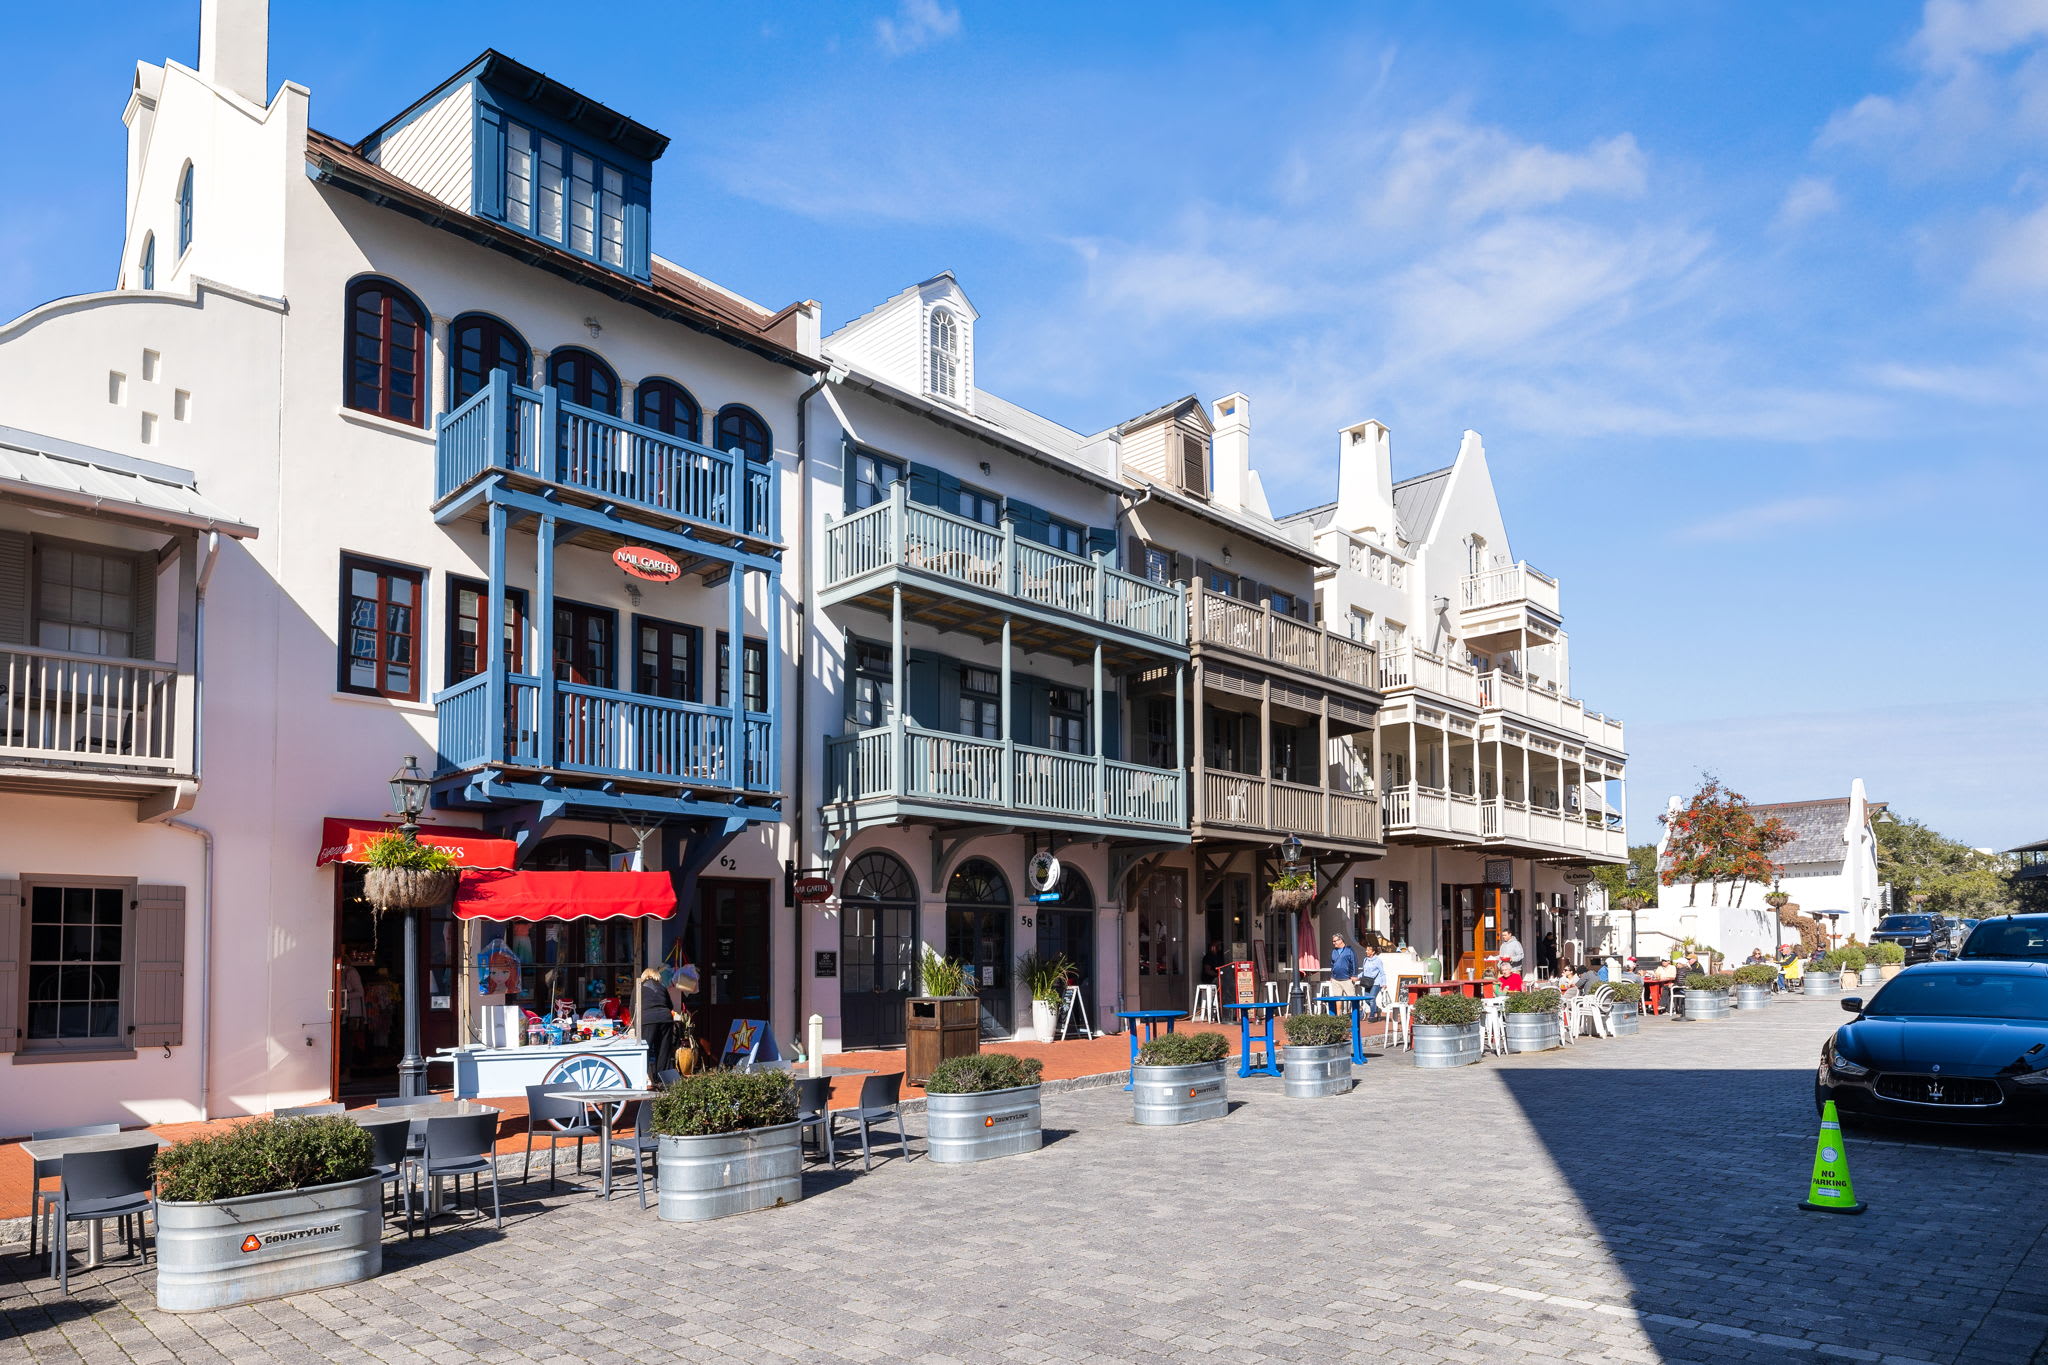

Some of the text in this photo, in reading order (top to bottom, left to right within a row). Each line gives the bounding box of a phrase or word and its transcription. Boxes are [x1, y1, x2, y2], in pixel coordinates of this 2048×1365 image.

[617, 551, 679, 574] NAIL GARTEN
[720, 855, 736, 871] 62
[1021, 915, 1033, 928] 58
[1254, 919, 1262, 931] 54
[1821, 1170, 1836, 1178] NO
[1812, 1177, 1848, 1187] PARKING
